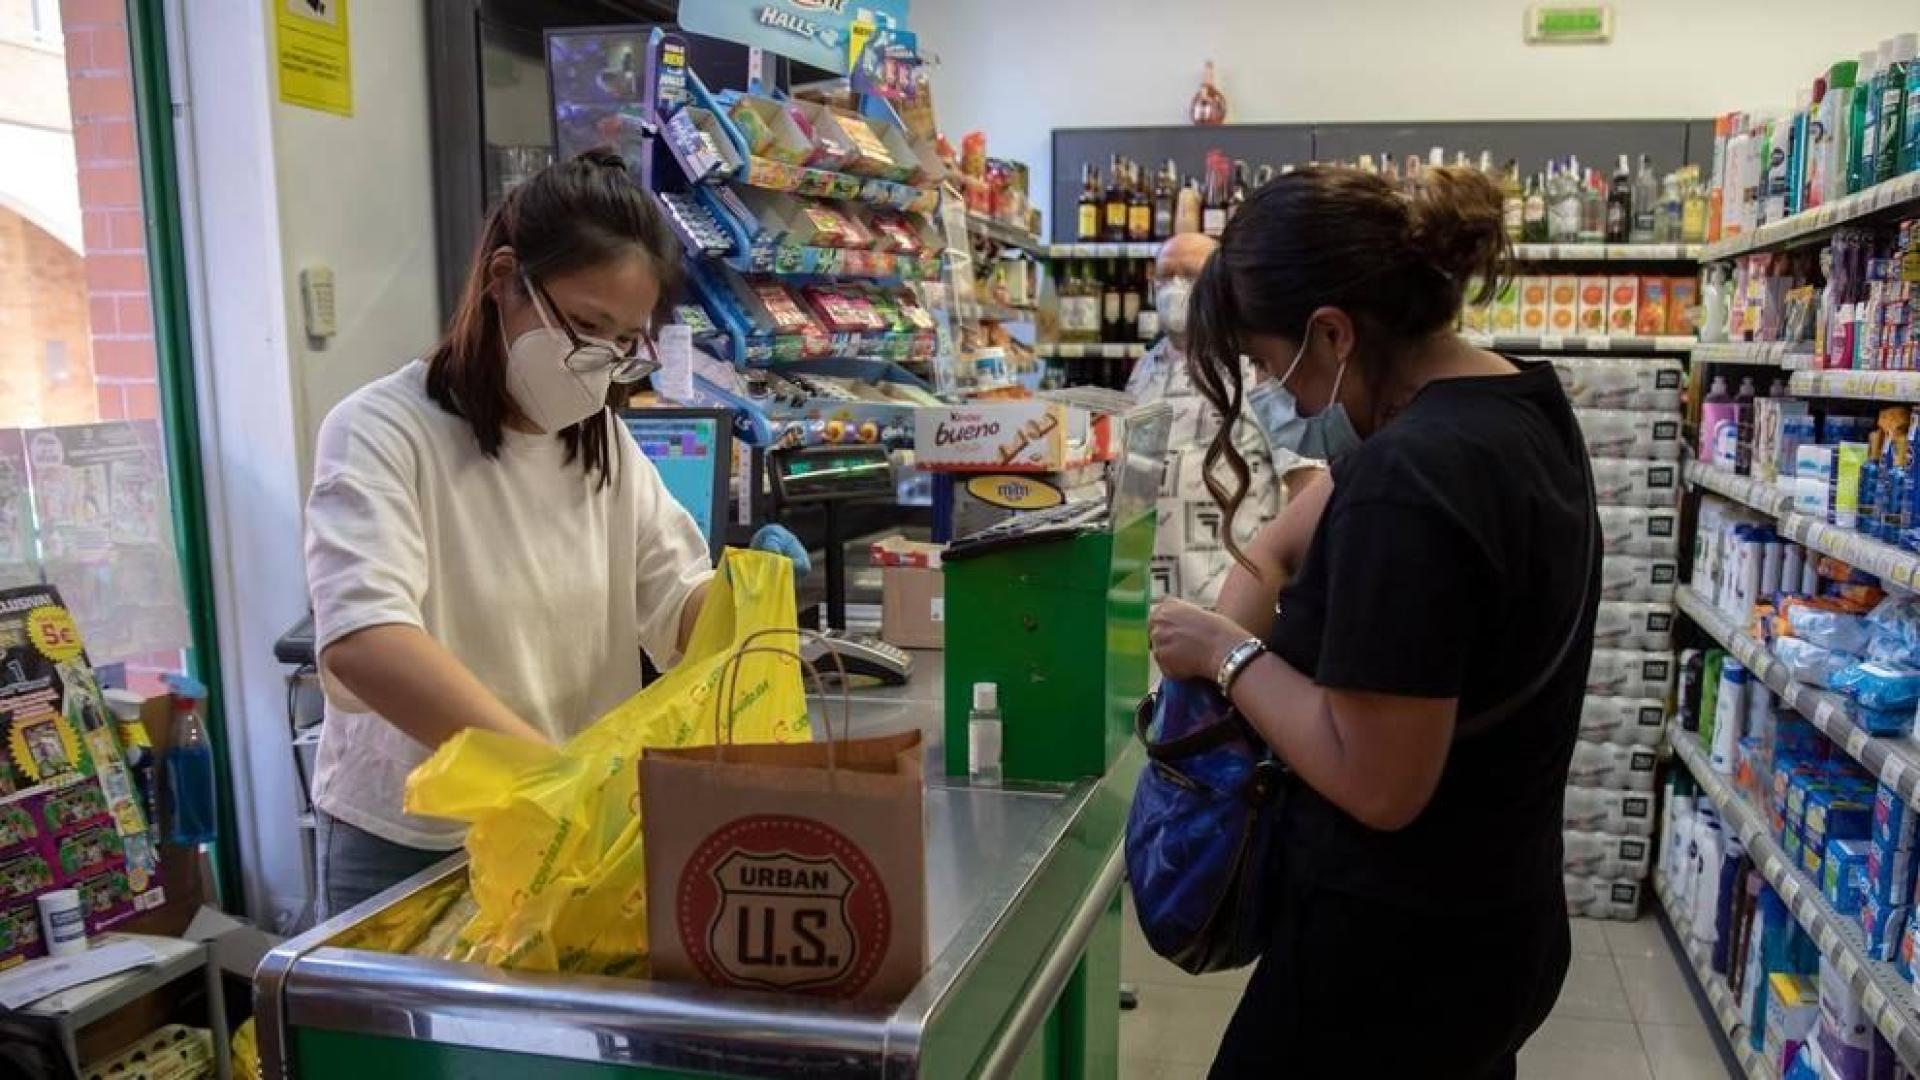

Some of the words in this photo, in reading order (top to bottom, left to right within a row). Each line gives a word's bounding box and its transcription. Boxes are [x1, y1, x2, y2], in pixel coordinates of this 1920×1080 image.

[758, 6, 817, 37] HALLS
[935, 421, 1000, 447] bueno
[739, 865, 830, 890] URBAN
[737, 904, 841, 968] U.S.
